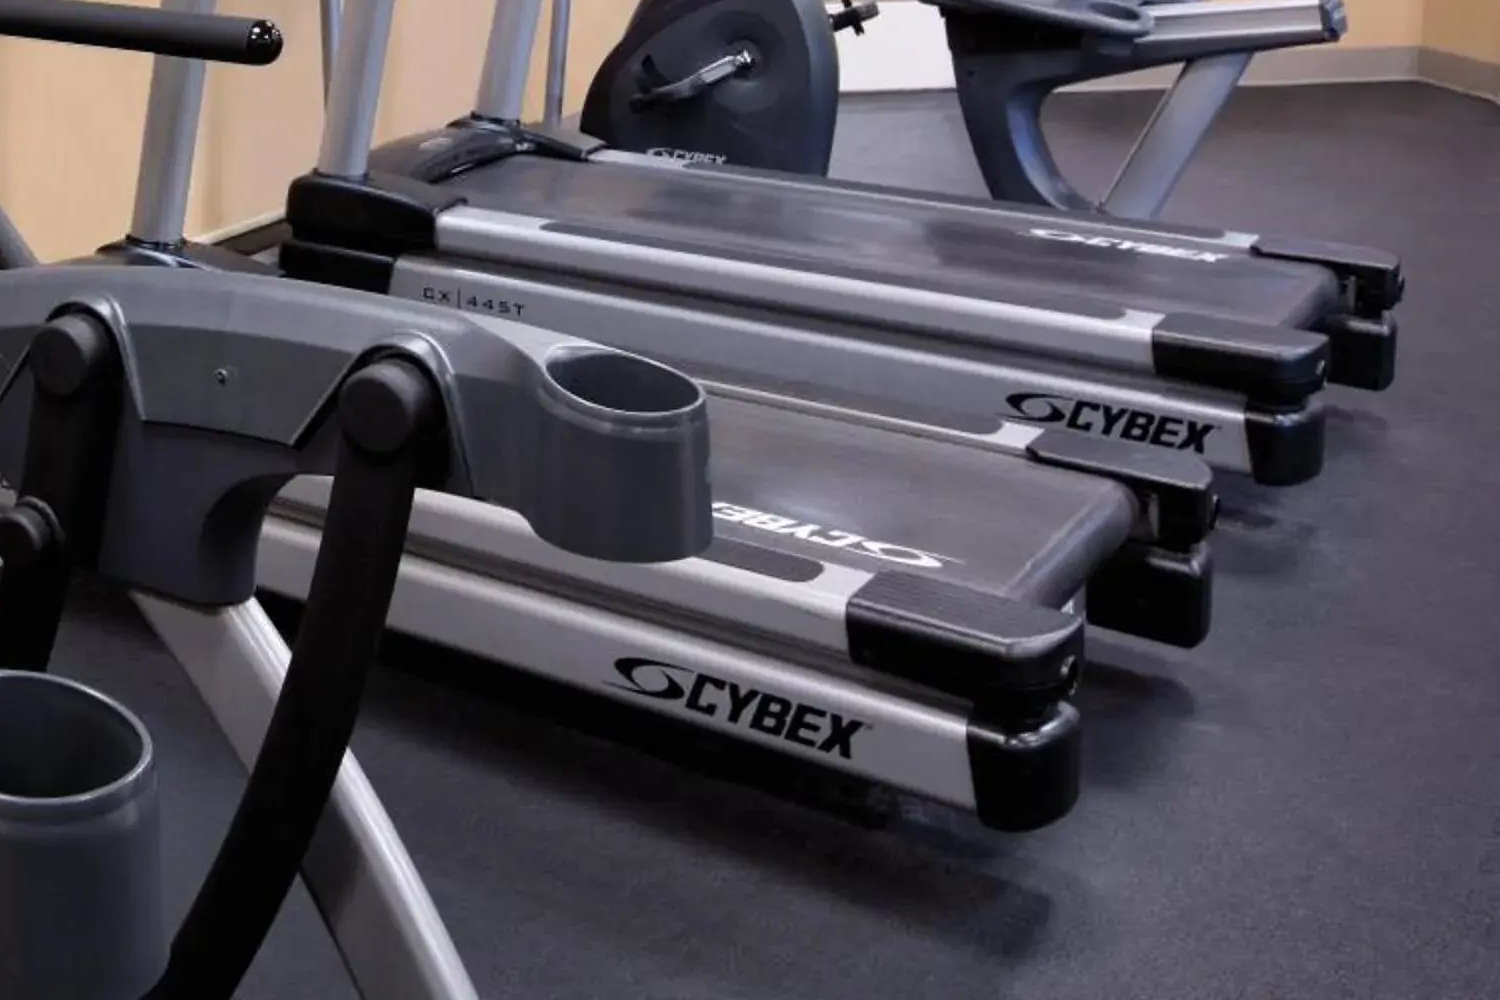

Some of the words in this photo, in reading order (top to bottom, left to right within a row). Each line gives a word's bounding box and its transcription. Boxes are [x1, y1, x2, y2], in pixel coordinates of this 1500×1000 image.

[1066, 399, 1215, 454] CYBEX
[711, 501, 864, 548] CYBE
[684, 672, 866, 760] CYBEX
